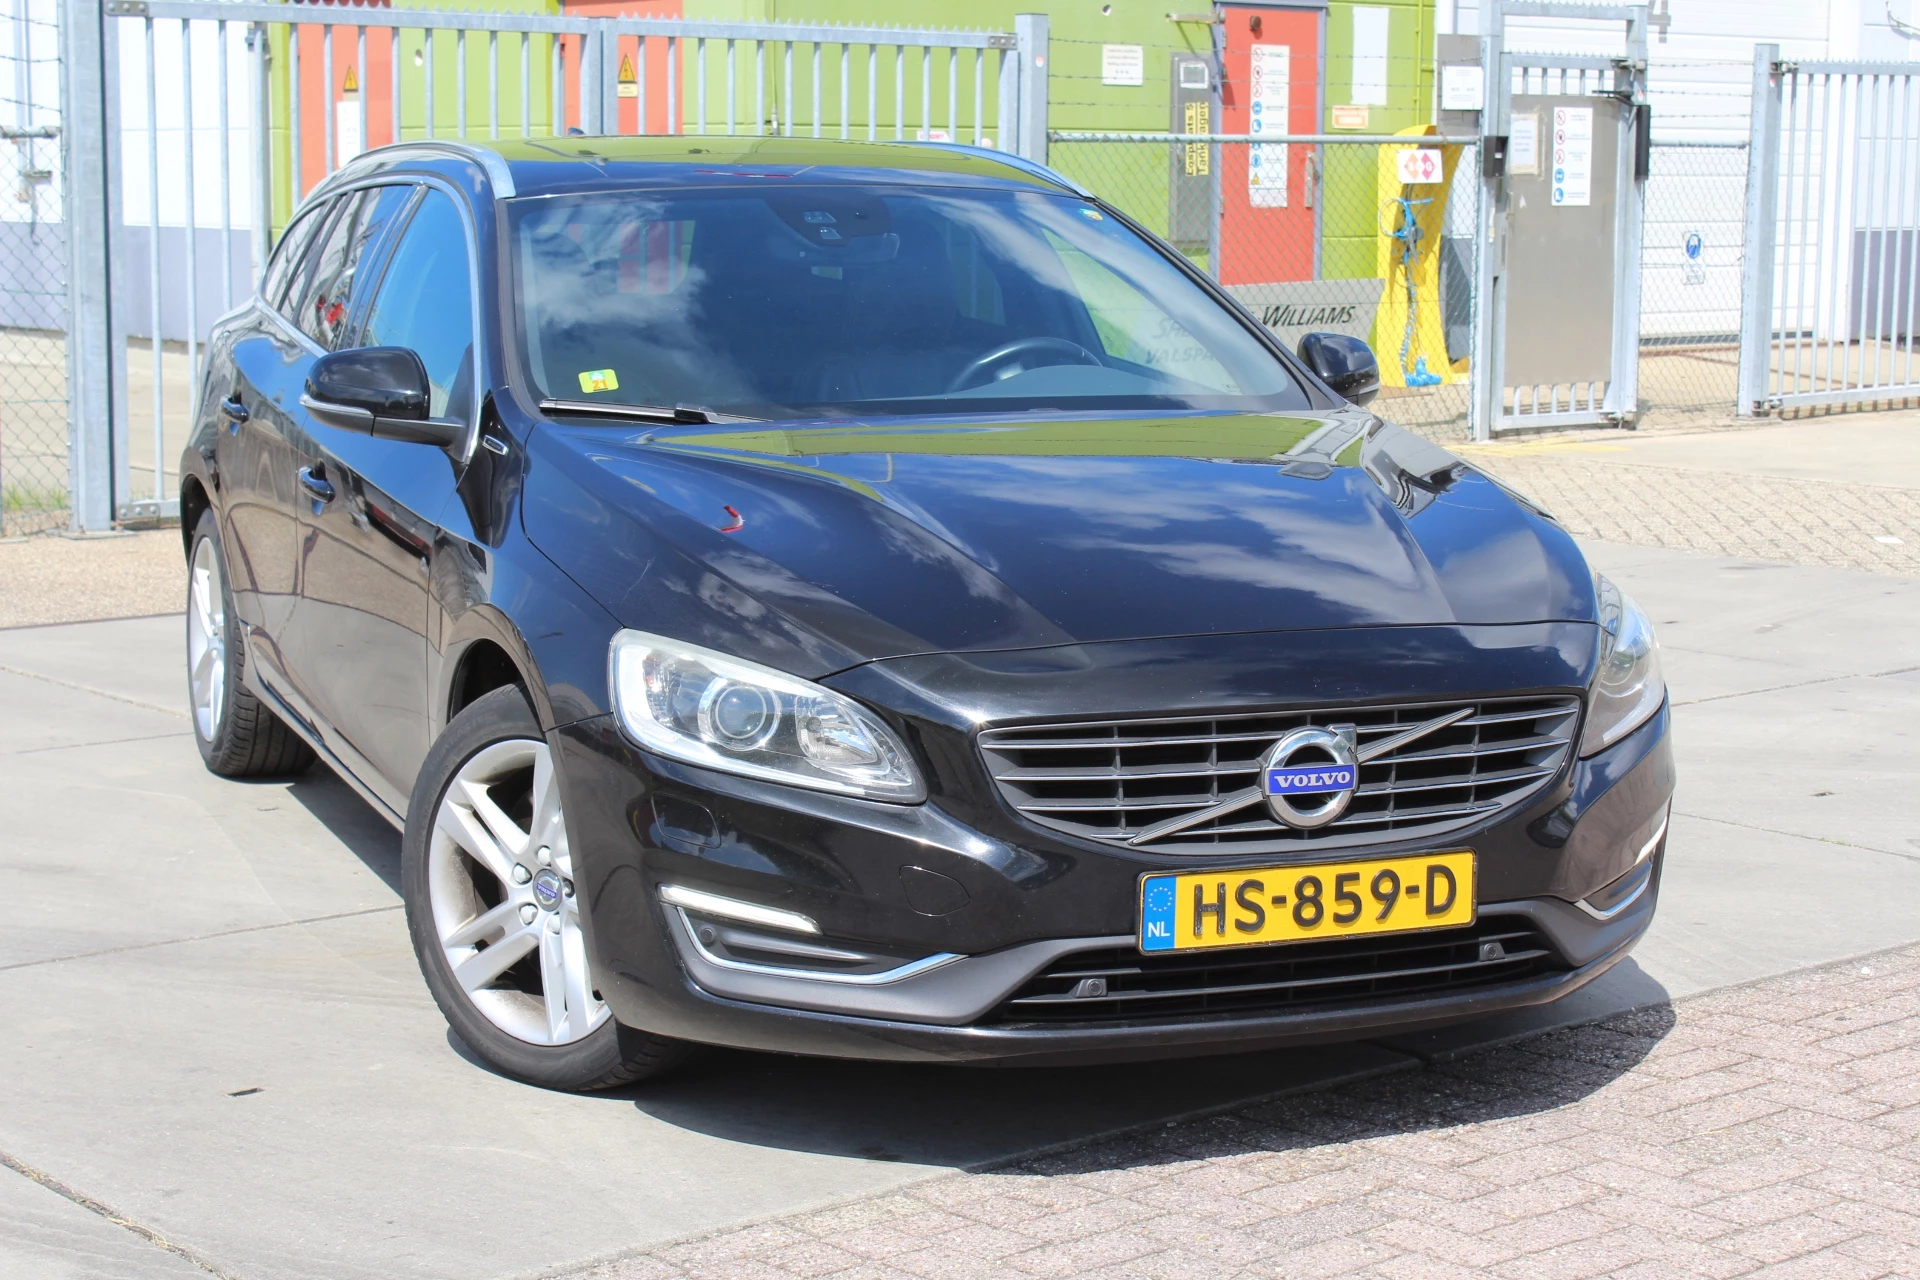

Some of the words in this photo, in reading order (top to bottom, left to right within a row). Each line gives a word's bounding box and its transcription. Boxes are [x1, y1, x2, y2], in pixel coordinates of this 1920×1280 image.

[1187, 115, 1195, 175] Losplats
[1197, 102, 1207, 174] Tankagen
[1145, 346, 1214, 364] VALSPA
[592, 380, 608, 390] 21
[1274, 771, 1350, 788] VOLVO
[537, 884, 556, 898] VOLVO
[1193, 864, 1457, 936] HS-859-D
[1148, 921, 1170, 938] NL
